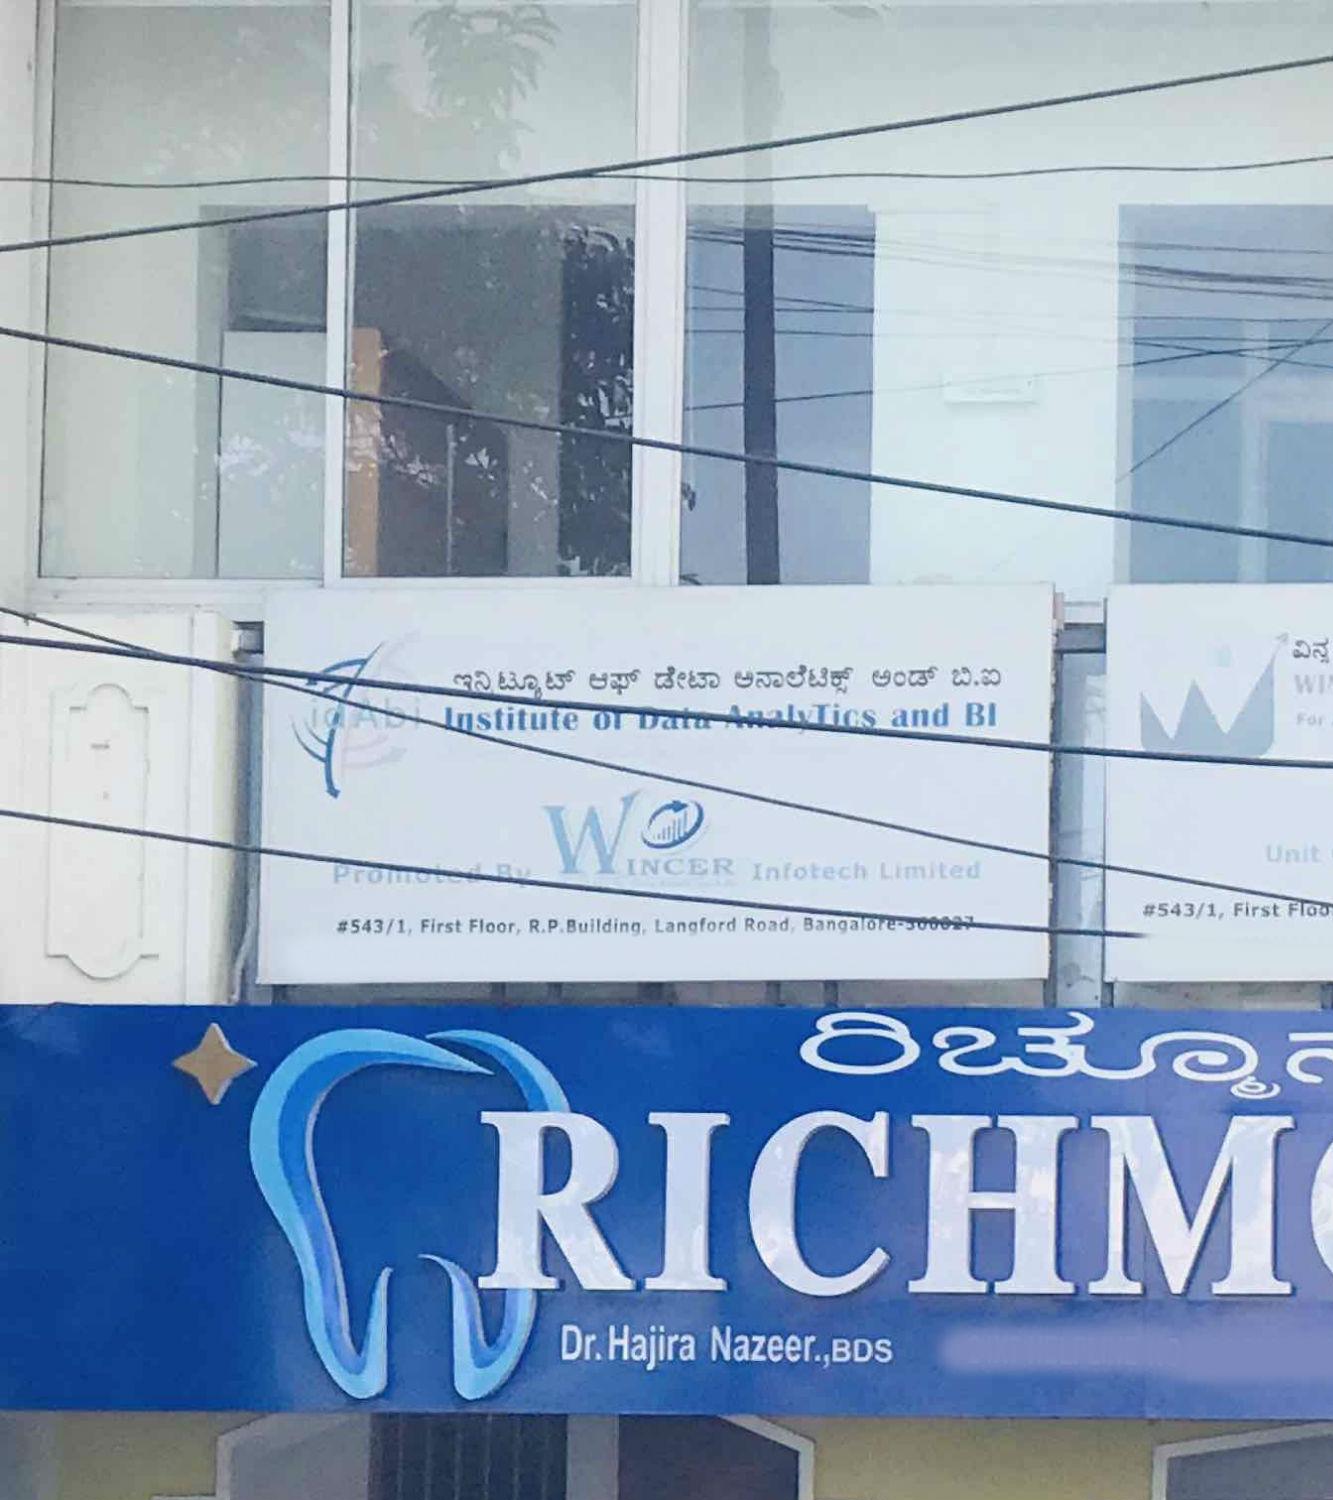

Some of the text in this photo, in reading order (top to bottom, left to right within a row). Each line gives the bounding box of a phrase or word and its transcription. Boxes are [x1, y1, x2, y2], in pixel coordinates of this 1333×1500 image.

[445, 706, 579, 733] Institute
[892, 702, 949, 728] and
[965, 702, 997, 728] BI
[541, 789, 736, 877] WINCER
[751, 861, 868, 882] Infotech
[880, 861, 982, 881] Limited
[1266, 844, 1320, 863] Unit
[1143, 902, 1225, 920] #543/1,
[1234, 902, 1280, 918] First
[336, 918, 413, 936] #543/1,
[420, 918, 462, 934] First
[469, 918, 521, 936] Floor,
[654, 917, 737, 935] Langford
[744, 917, 796, 935] Road,
